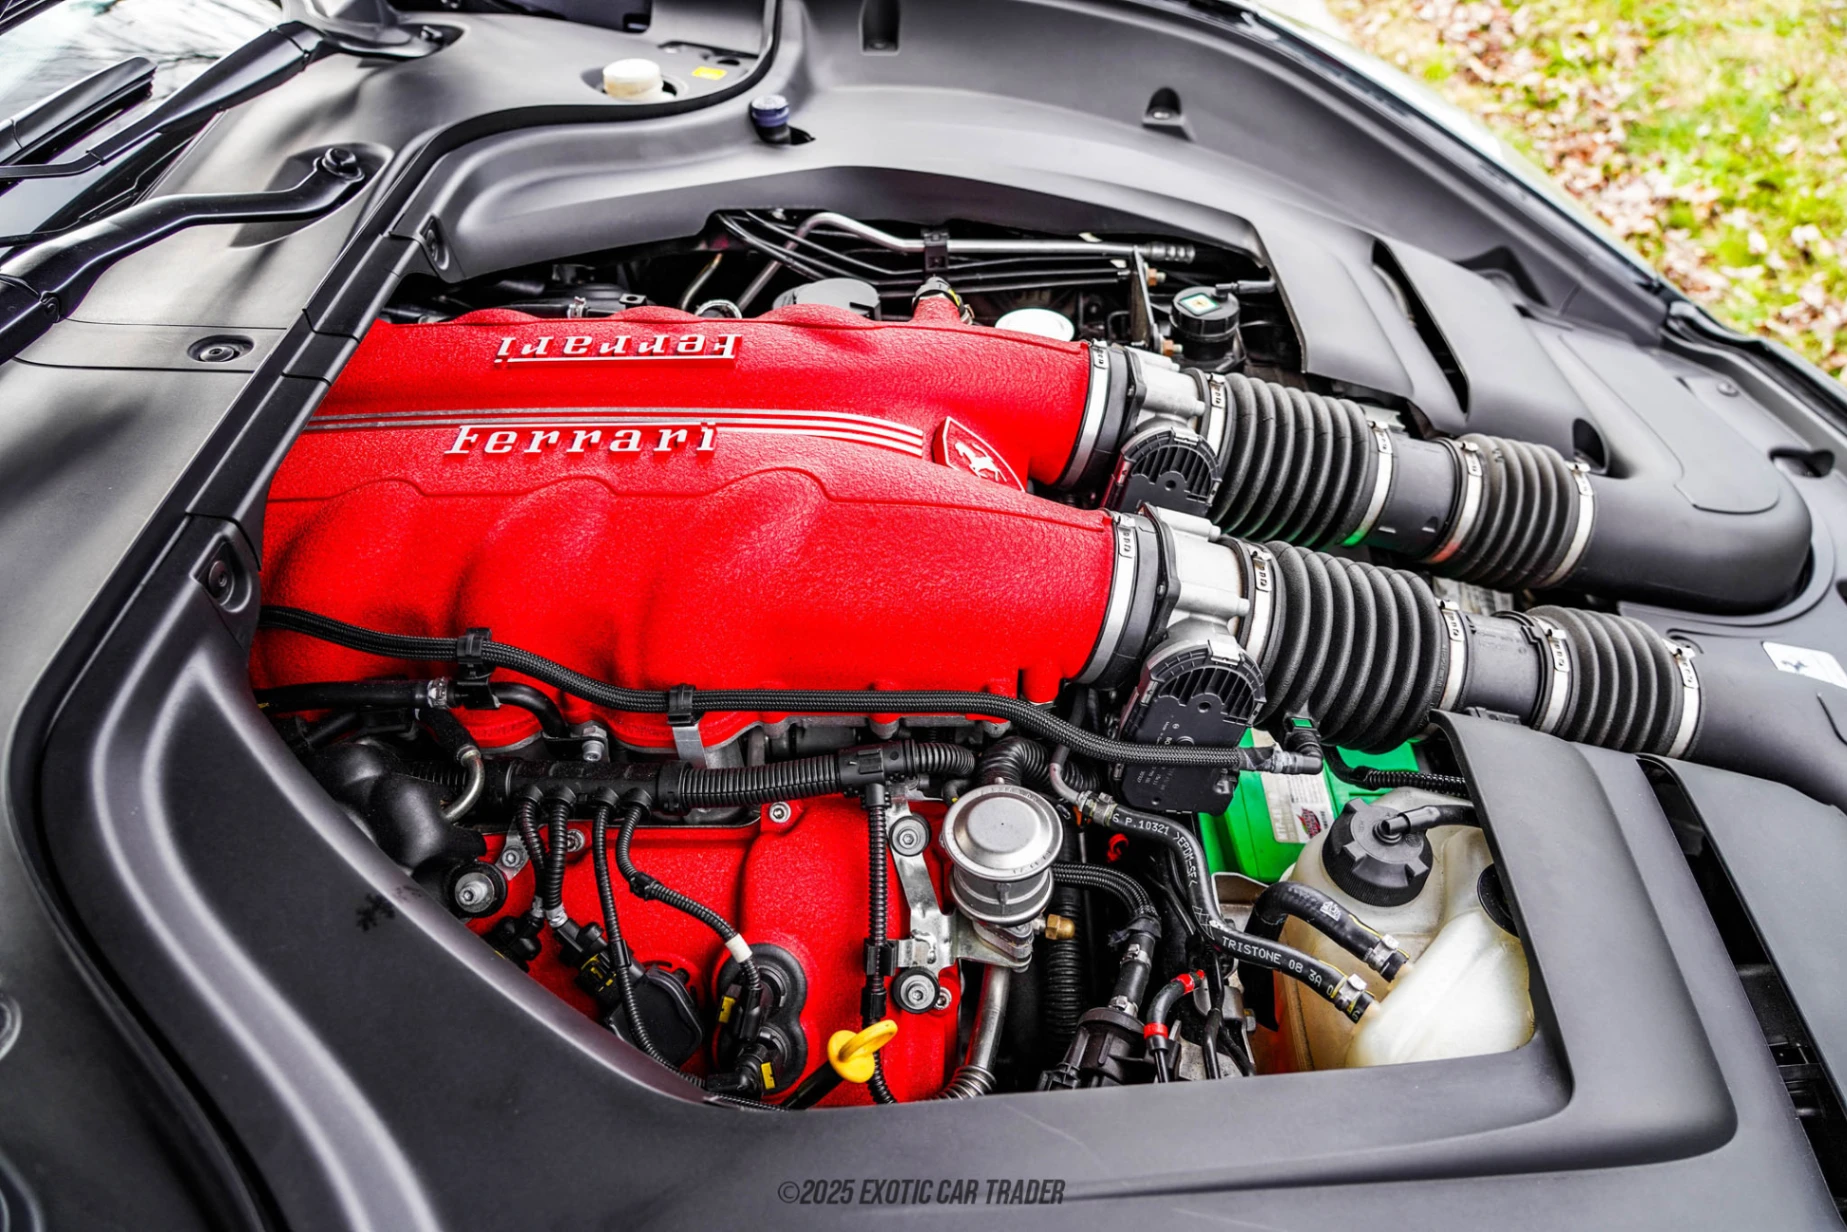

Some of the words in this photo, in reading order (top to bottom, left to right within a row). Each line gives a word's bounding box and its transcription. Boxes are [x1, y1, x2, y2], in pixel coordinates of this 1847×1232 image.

[494, 333, 742, 363] Ferrari
[444, 422, 717, 454] Ferrari
[1125, 816, 1170, 836] P.10321
[1222, 936, 1282, 965] TRISTONE
